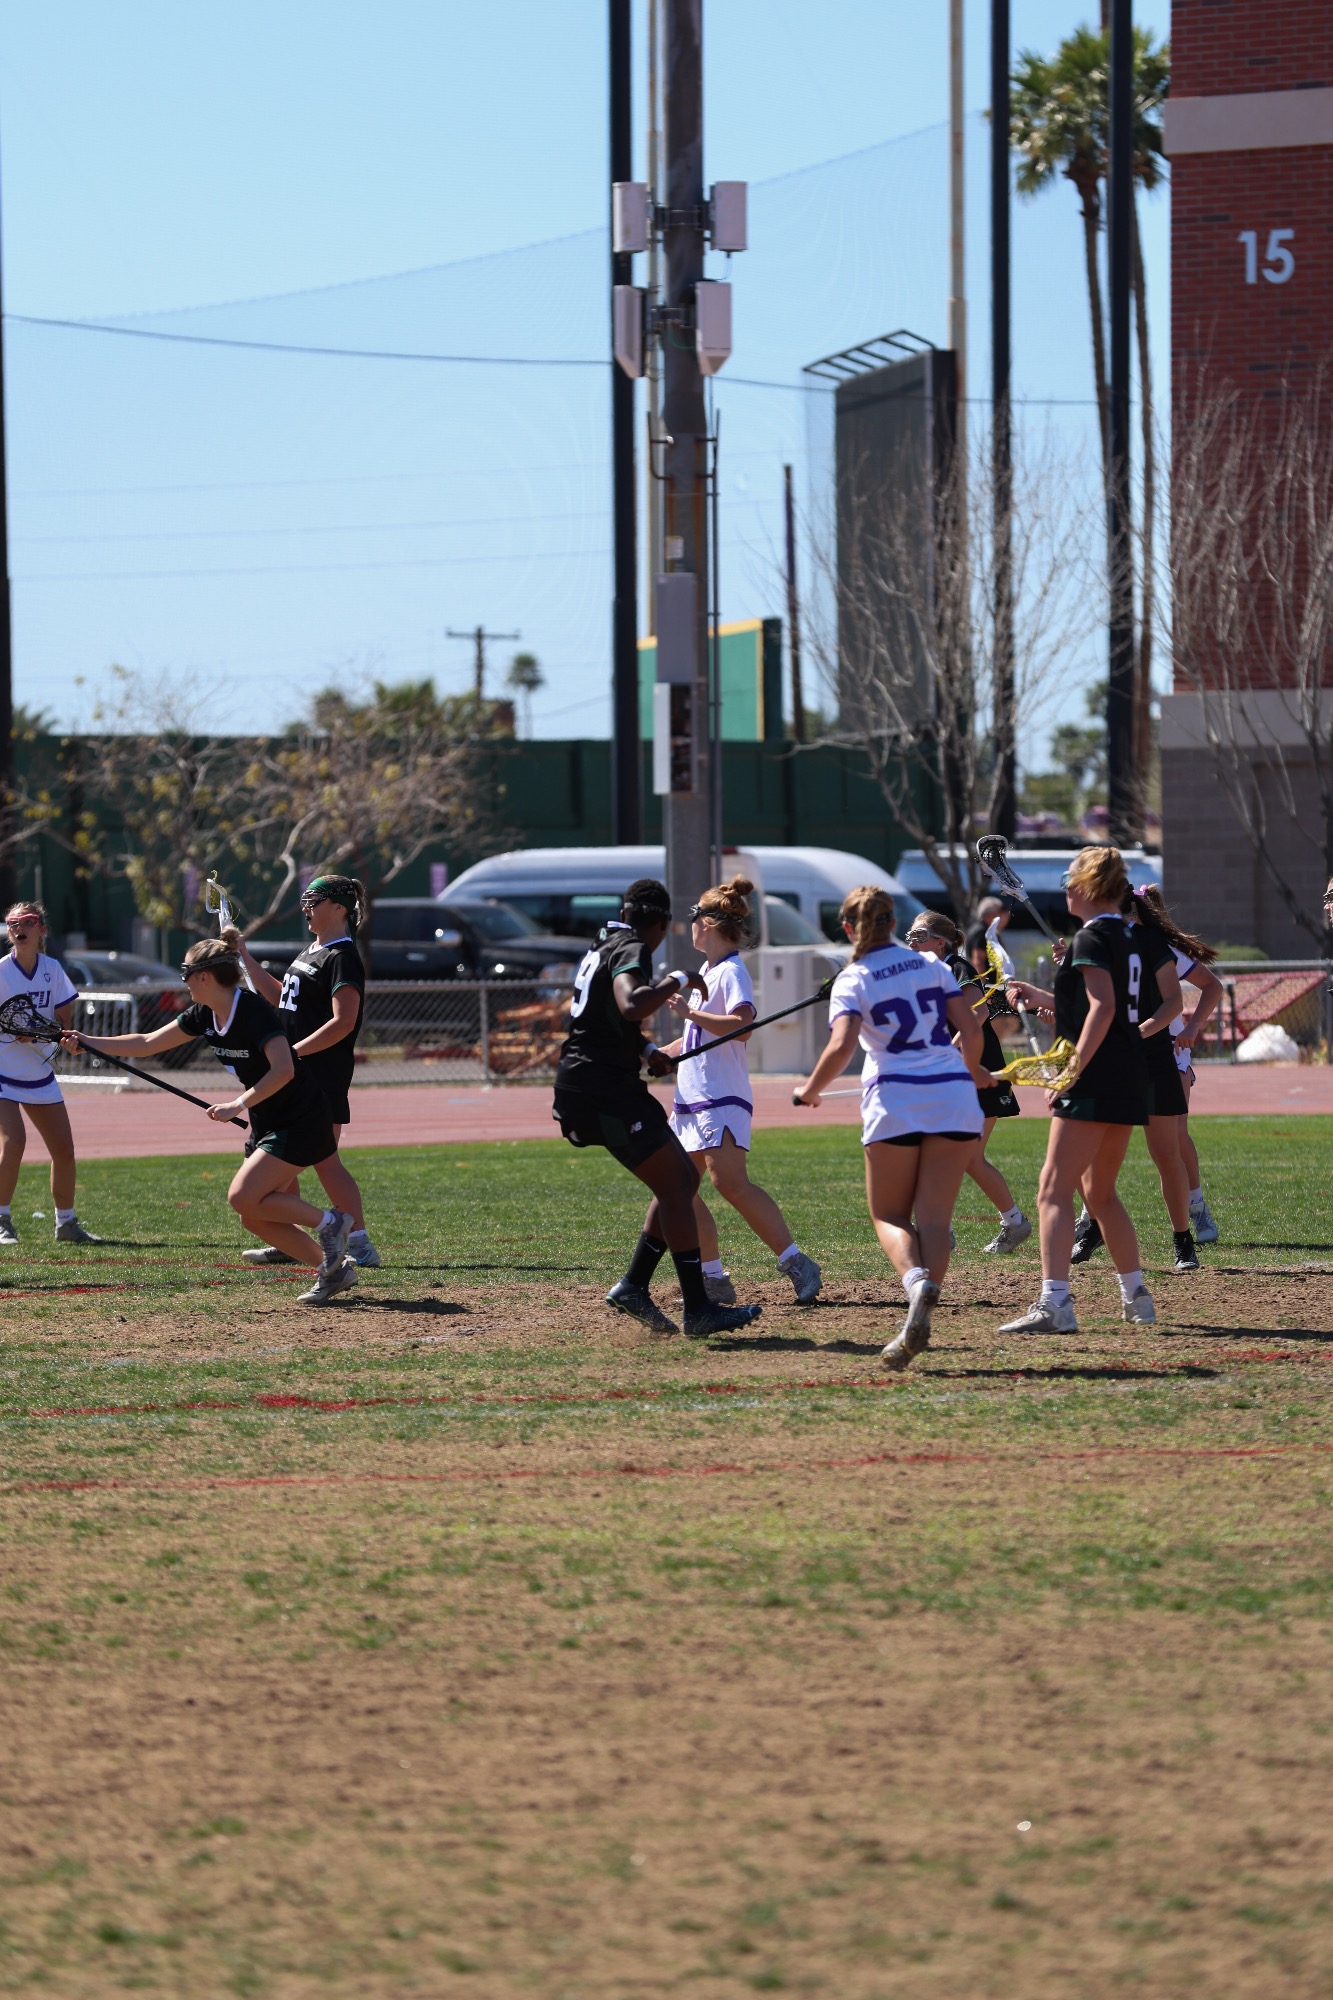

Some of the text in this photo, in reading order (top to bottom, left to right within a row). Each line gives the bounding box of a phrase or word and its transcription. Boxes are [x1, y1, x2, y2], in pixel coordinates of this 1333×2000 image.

[1237, 228, 1295, 285] 15
[279, 973, 300, 1012] 22
[570, 949, 600, 1019] 9
[872, 959, 926, 981] MCMAHON
[1127, 953, 1142, 1023] 9
[869, 986, 953, 1055] 22
